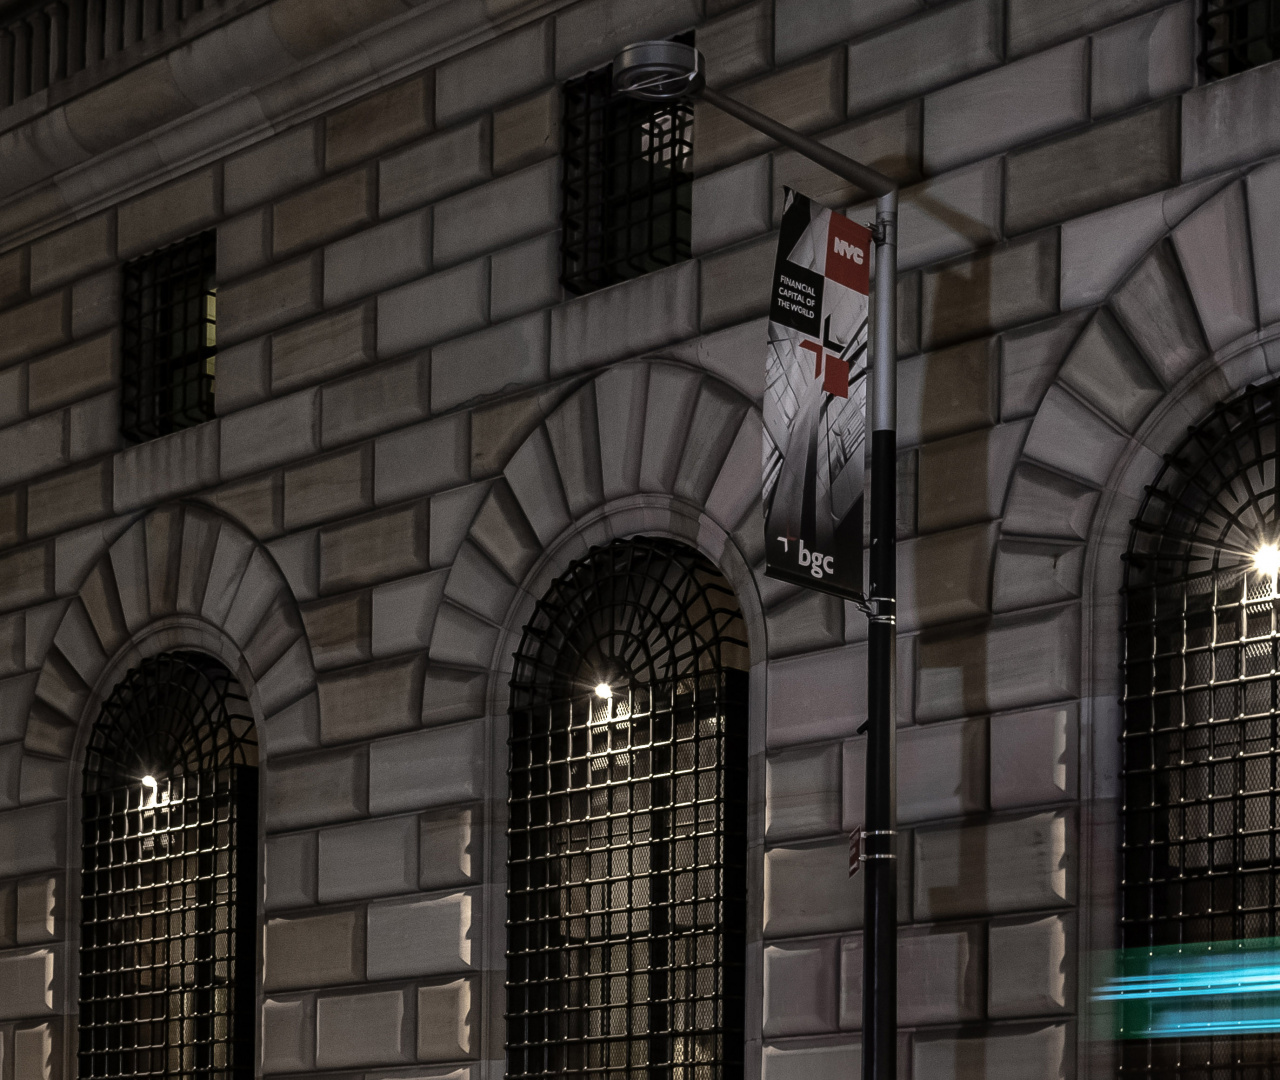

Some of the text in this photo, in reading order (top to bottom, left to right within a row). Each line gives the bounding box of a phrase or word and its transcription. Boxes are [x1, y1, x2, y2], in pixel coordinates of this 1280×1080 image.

[833, 236, 864, 265] NYC
[778, 287, 816, 307] CAPITAL OF
[780, 274, 816, 297] FINANCIAL
[777, 297, 815, 319] THE WORLD
[798, 538, 834, 578] bgc
